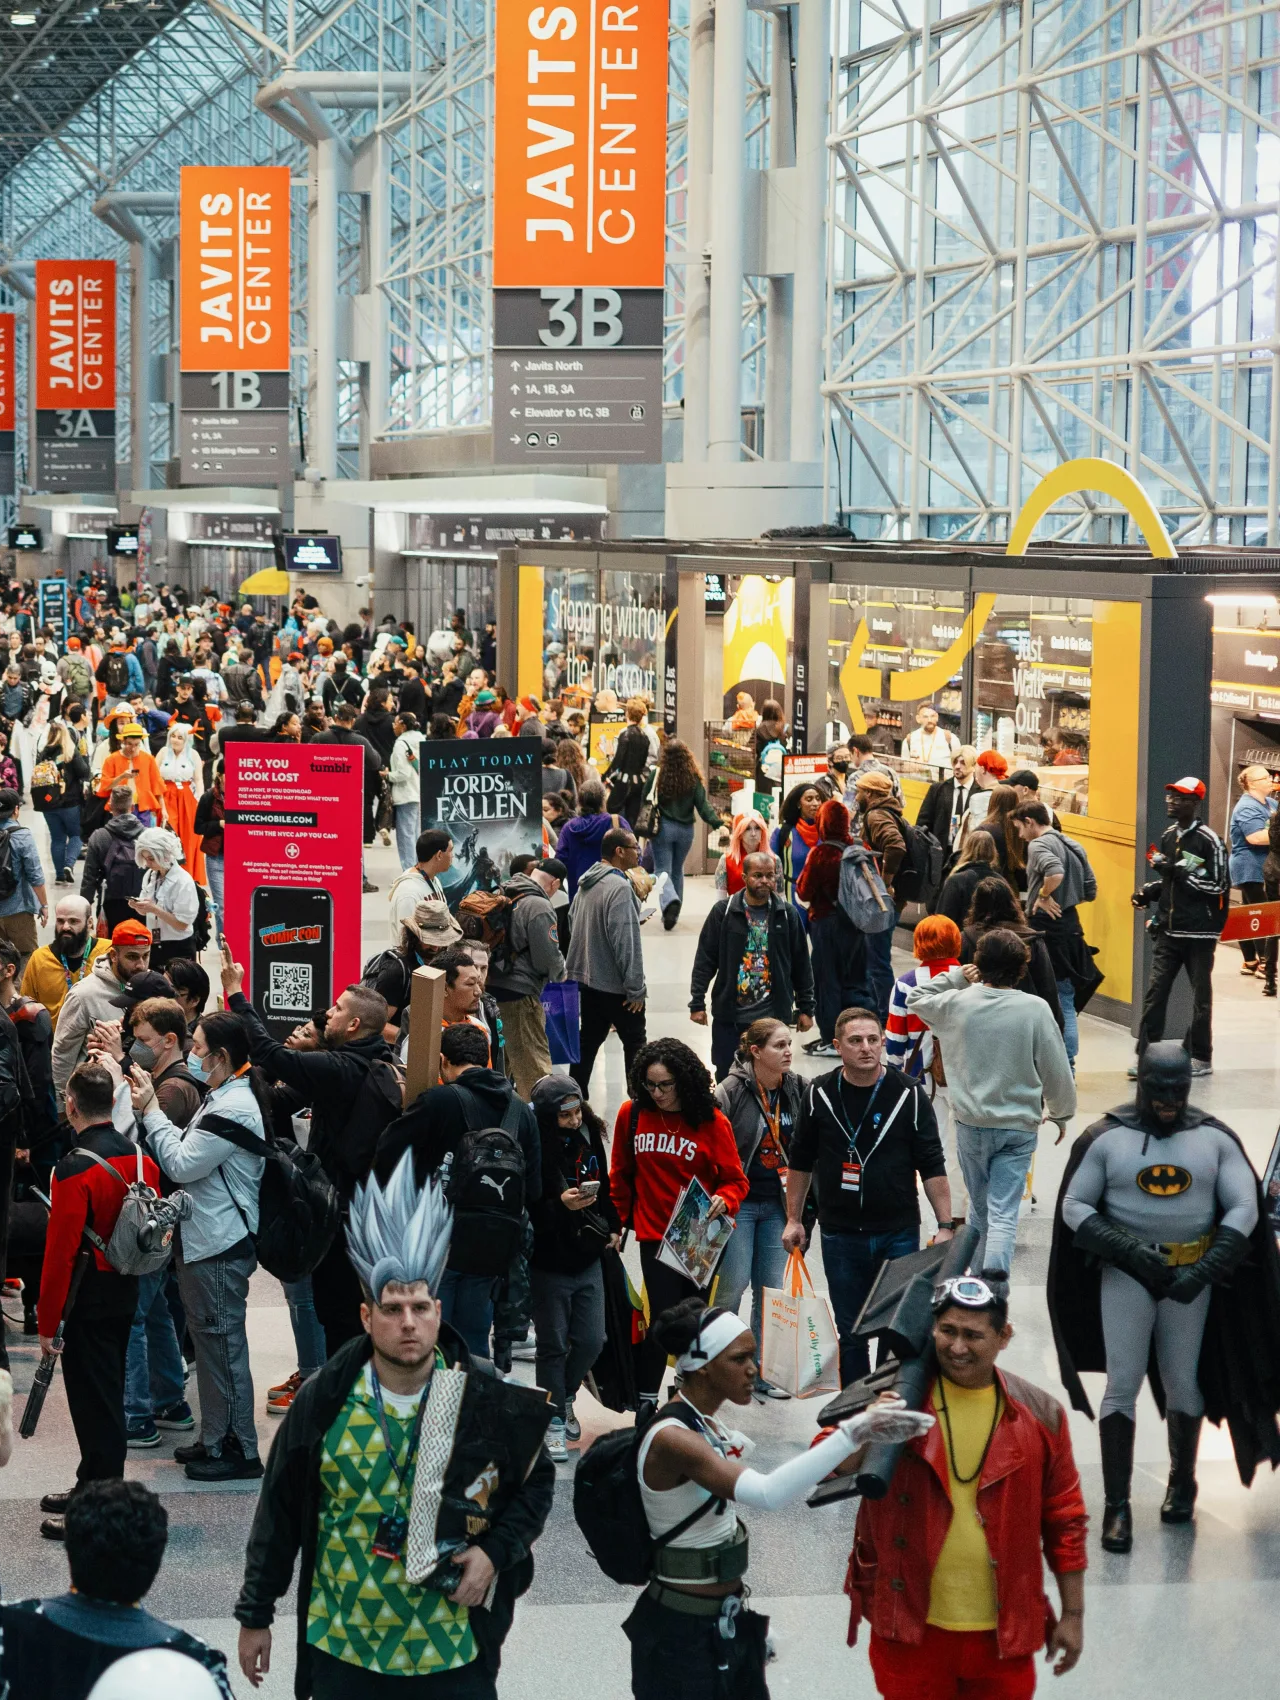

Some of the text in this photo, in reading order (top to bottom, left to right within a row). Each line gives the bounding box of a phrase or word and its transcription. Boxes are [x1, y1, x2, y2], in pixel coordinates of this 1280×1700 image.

[526, 6, 578, 242] JAVITS
[598, 4, 639, 245] CENTER
[200, 193, 233, 342] JAVITS
[245, 193, 271, 344] CENTER
[538, 288, 623, 347] 3B
[49, 279, 74, 388] JAVITS
[83, 278, 103, 389] CENTER
[525, 361, 583, 371] Javits North
[211, 372, 262, 409] 1B
[525, 384, 575, 395] 1A, 1B, 3A
[55, 410, 98, 438] 3A
[524, 407, 610, 419] Elevator to 1C, 3B
[551, 588, 666, 646] Shopping withou
[1015, 631, 1044, 662] Just
[566, 646, 655, 703] the checkout
[1012, 667, 1046, 699] Walk
[1015, 703, 1041, 734] Out
[238, 758, 289, 769] HEY, YOU
[310, 763, 352, 773] tumblr
[429, 754, 534, 770] PLAY TODAY
[238, 772, 299, 783] LOOK LOST
[444, 774, 505, 795] LORDS
[238, 814, 313, 824] NYCCMOBILE.COM
[436, 792, 527, 822] FALLEN
[263, 926, 320, 945] COMIC CON
[634, 1133, 698, 1161] FOR DAYS
